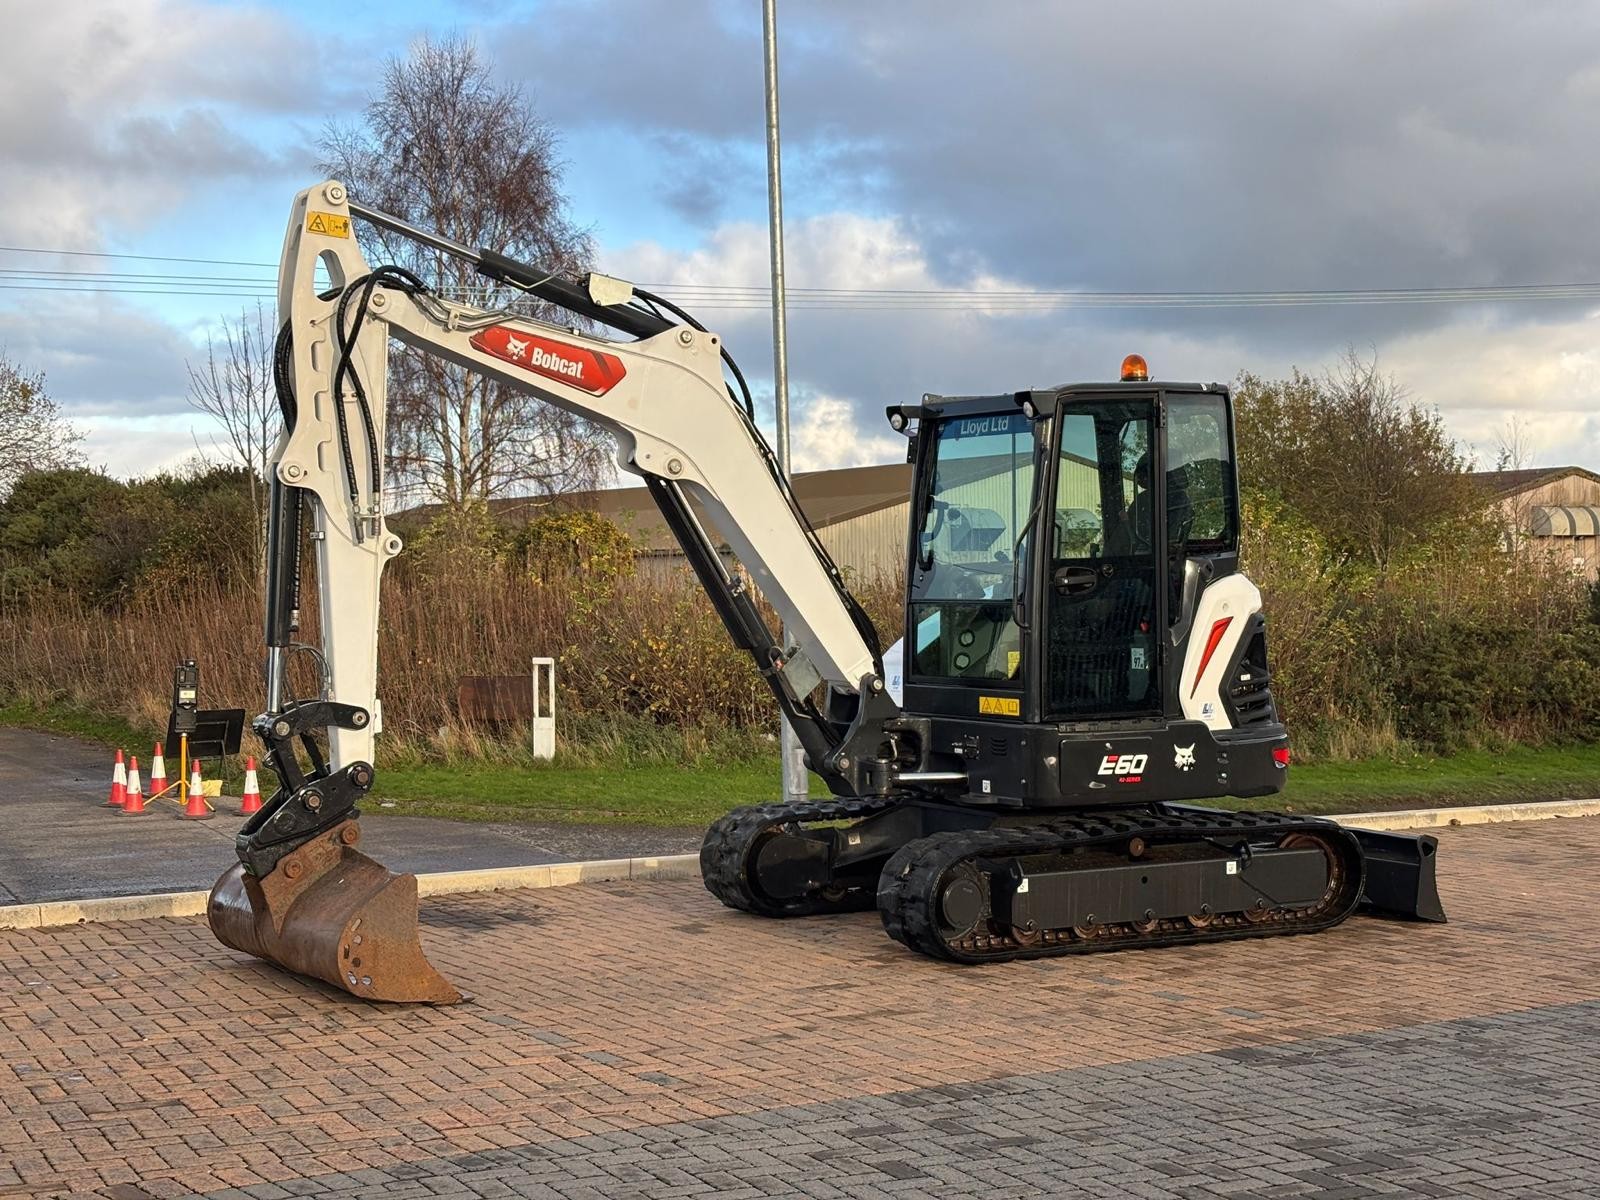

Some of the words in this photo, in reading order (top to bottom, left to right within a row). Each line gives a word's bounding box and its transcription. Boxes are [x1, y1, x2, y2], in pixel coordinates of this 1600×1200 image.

[531, 347, 583, 379] Bobcat
[960, 418, 989, 436] Lloyd
[991, 416, 1009, 432] Ltd
[1097, 753, 1149, 775] E60
